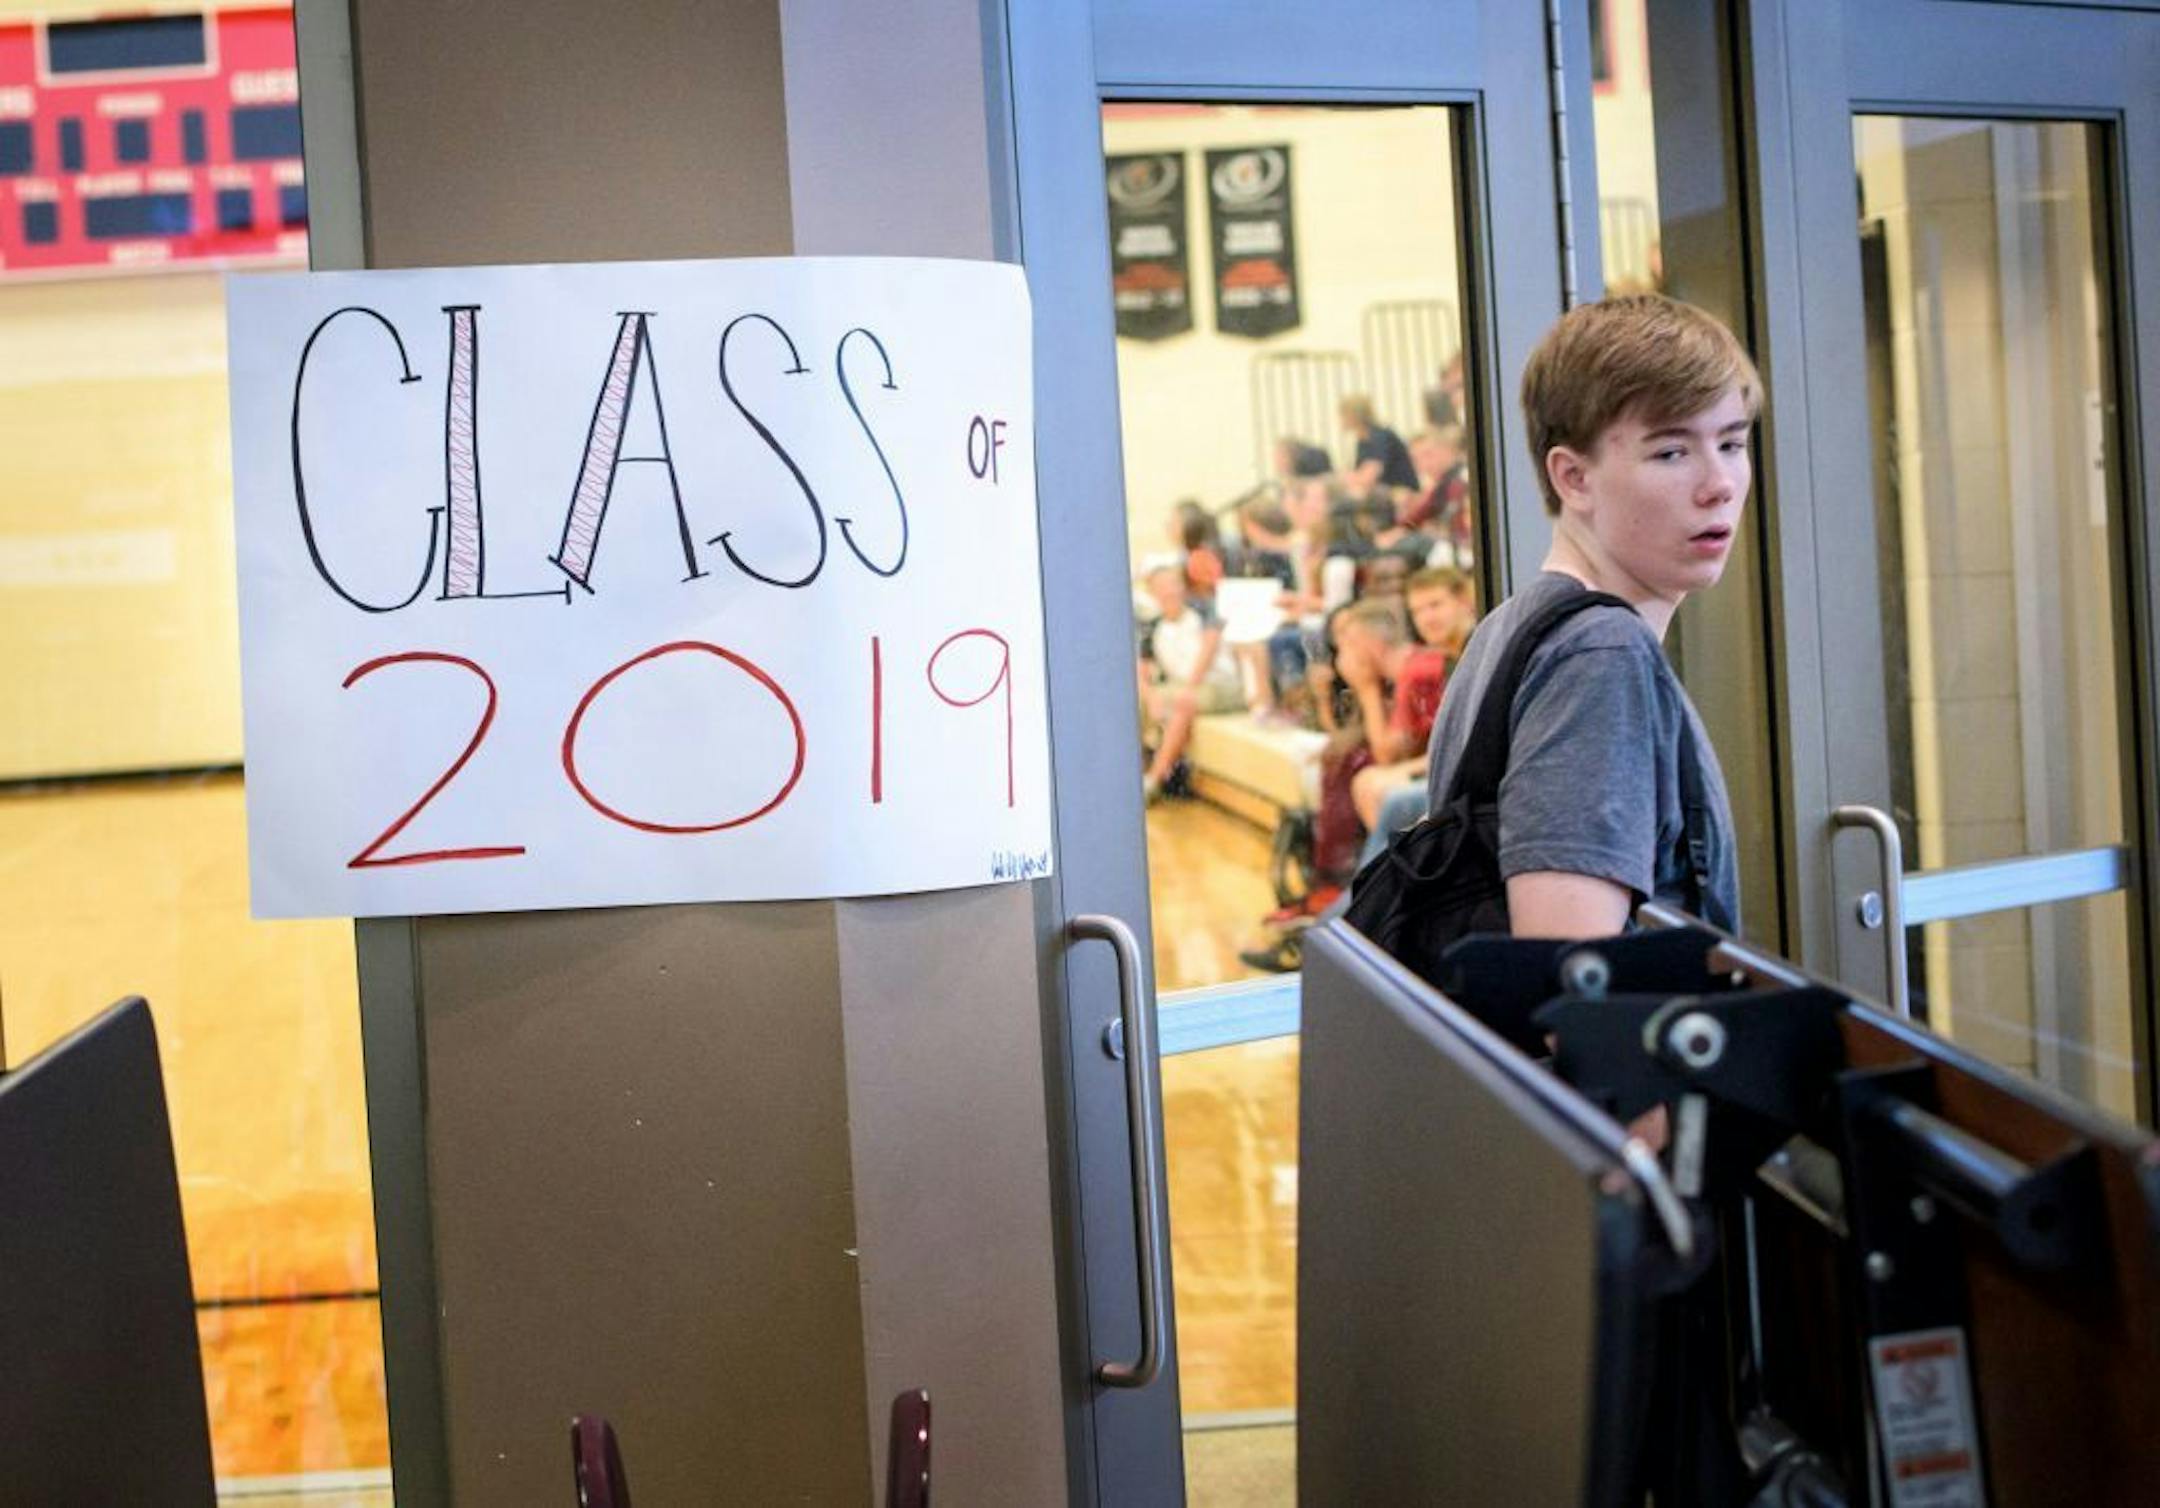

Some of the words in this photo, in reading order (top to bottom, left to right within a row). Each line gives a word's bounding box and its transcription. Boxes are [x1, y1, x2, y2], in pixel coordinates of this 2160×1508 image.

[291, 305, 909, 612] CLASS
[967, 415, 1007, 485] OF
[342, 628, 1016, 870] 2019
